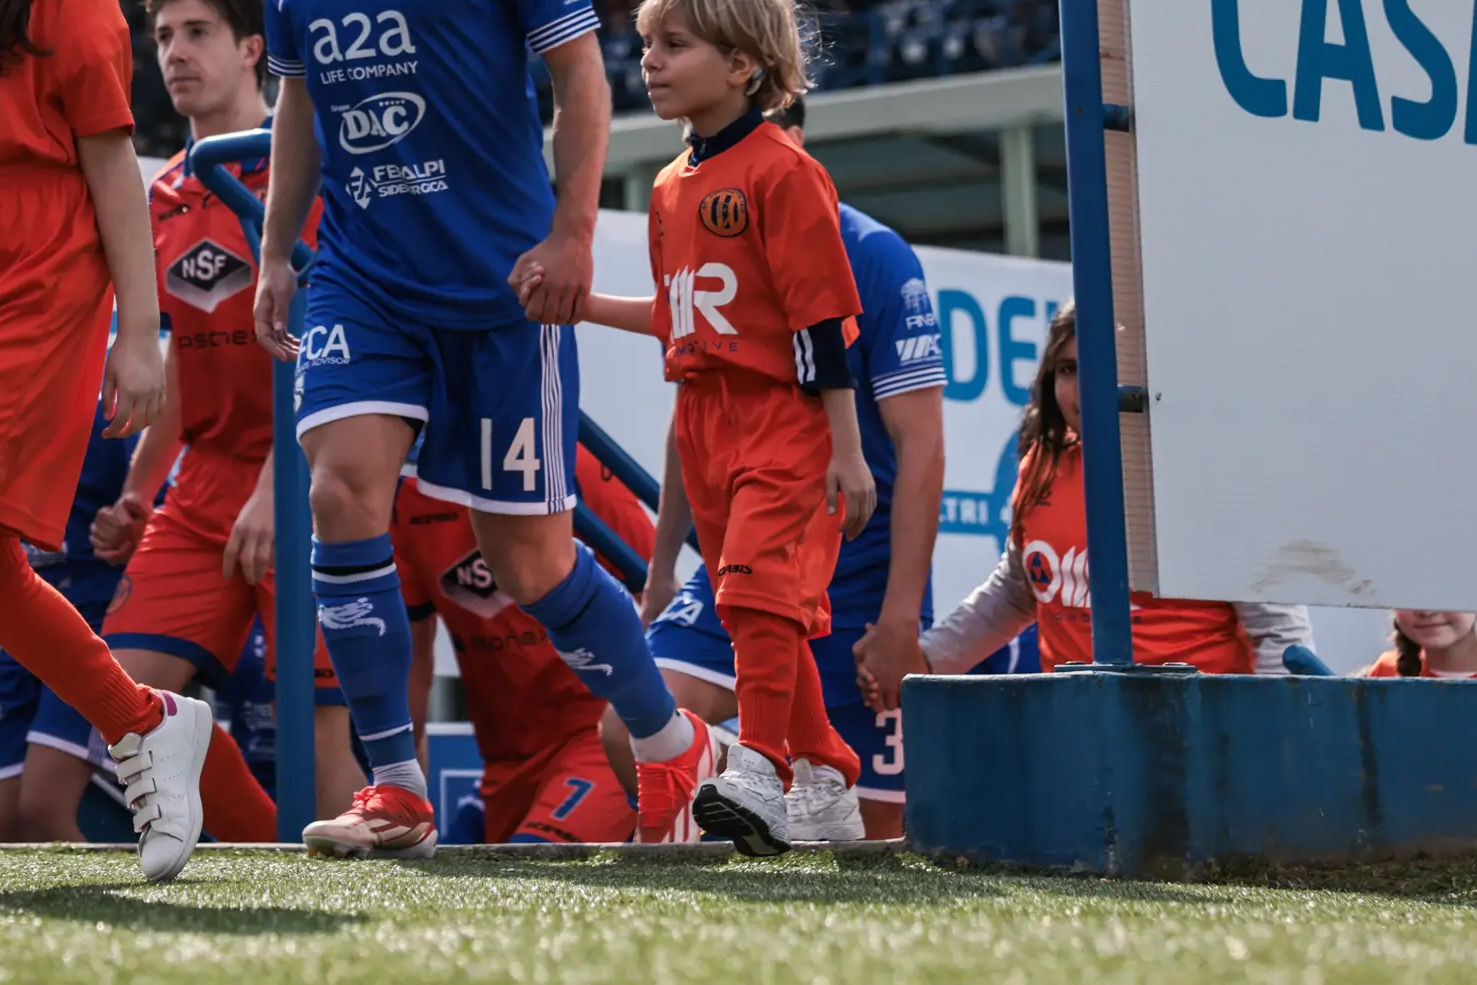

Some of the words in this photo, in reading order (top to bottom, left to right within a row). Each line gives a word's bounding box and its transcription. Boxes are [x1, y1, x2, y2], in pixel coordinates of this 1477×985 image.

[309, 10, 416, 65] a2a
[320, 69, 346, 85] LIFE
[348, 61, 419, 80] COMPANY
[342, 105, 409, 140] DAC
[373, 159, 445, 181] FEALPI
[182, 250, 227, 281] NSF
[937, 288, 1058, 407] DE
[481, 417, 540, 491] 14
[457, 558, 493, 589] NS
[551, 778, 595, 821] 7
